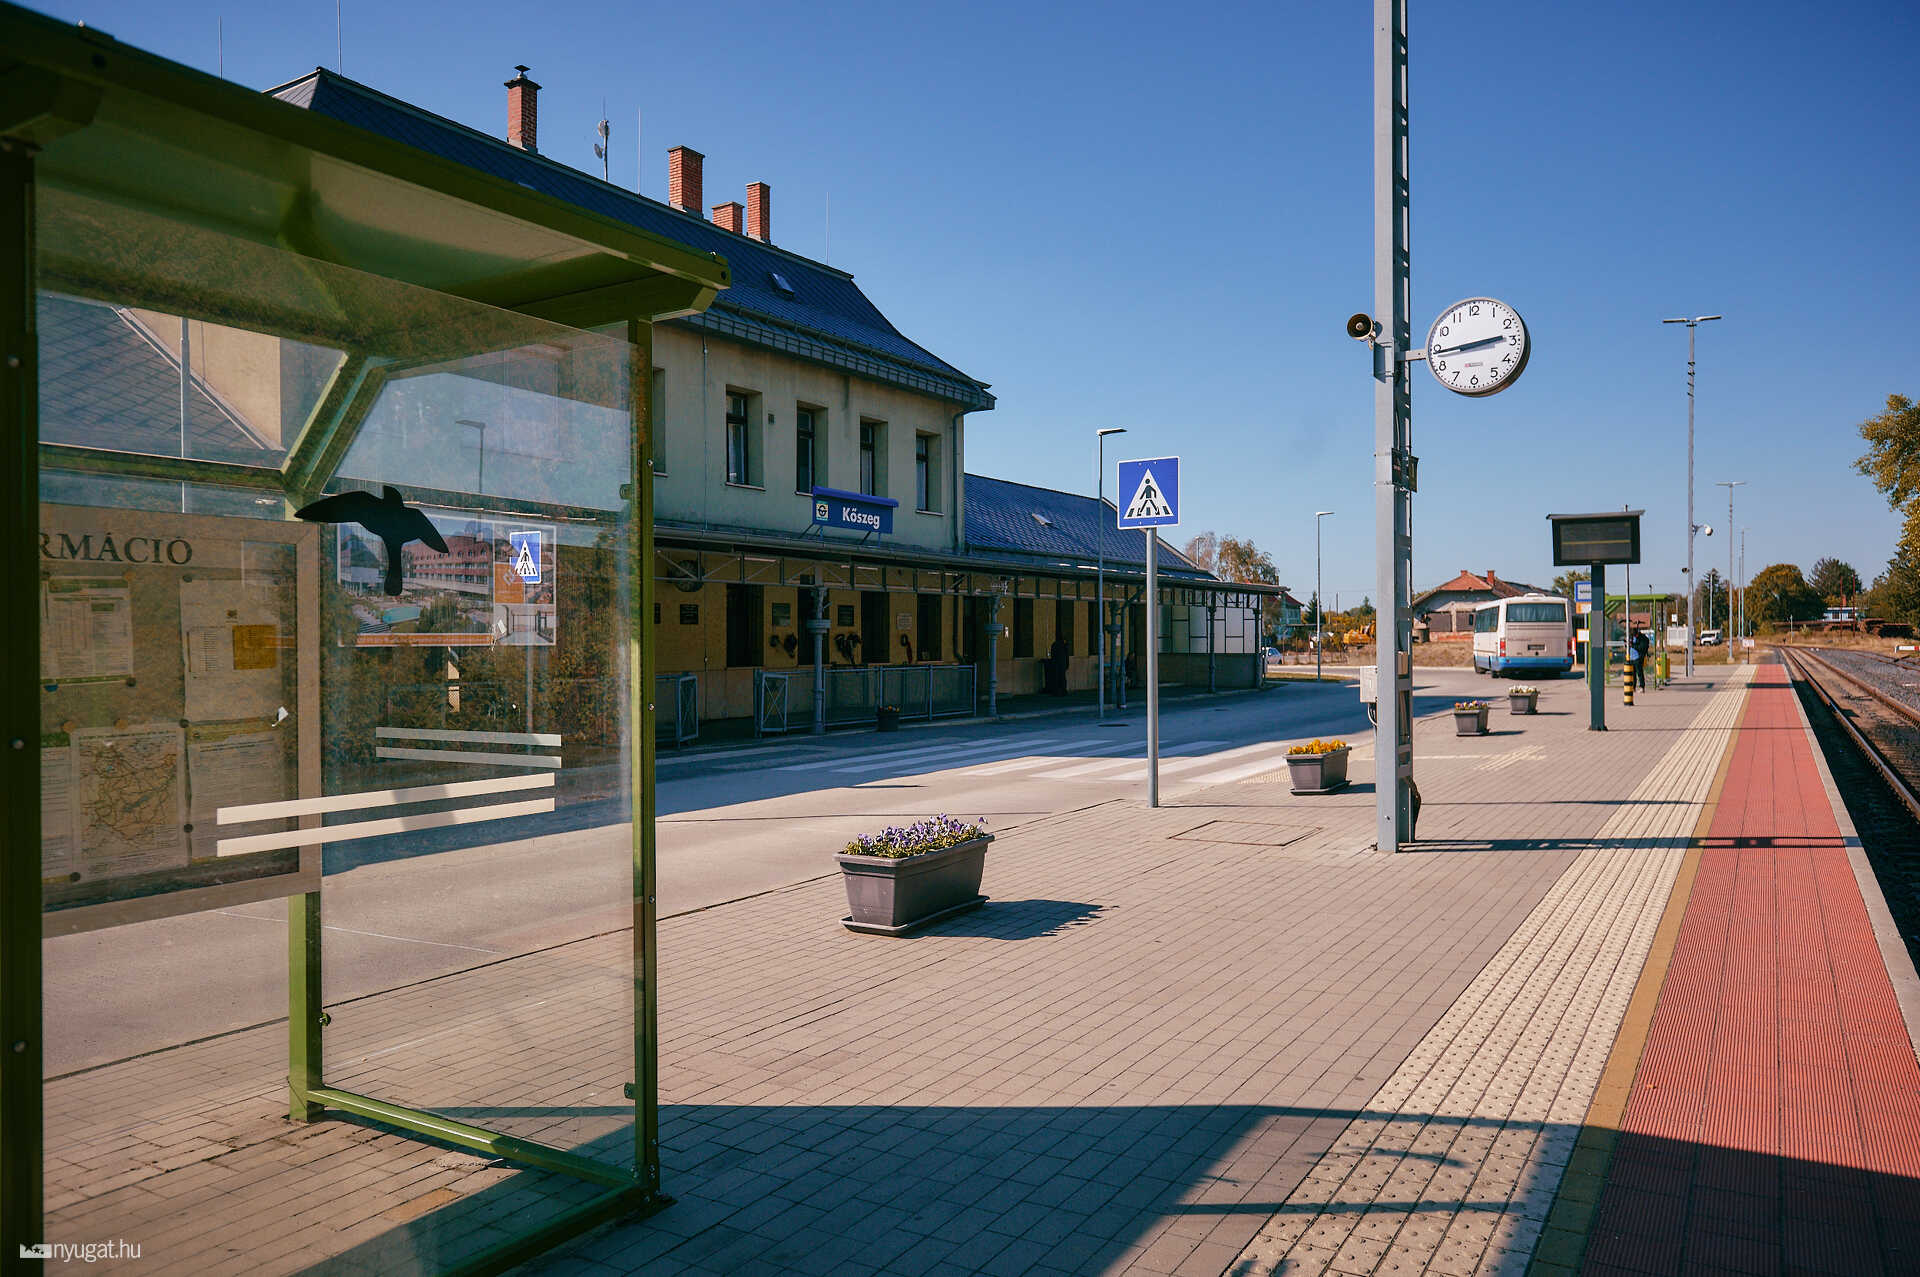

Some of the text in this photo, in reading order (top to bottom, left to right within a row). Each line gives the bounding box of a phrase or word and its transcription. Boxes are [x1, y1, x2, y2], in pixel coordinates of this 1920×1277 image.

[1469, 305, 1480, 316] 12
[1453, 312, 1462, 323] 11
[1503, 318, 1512, 329] 2
[1440, 326, 1449, 337] 10
[1508, 335, 1517, 346] 3
[1502, 353, 1511, 364] 4
[1438, 361, 1446, 371] 8
[1452, 371, 1460, 381] 7
[1490, 367, 1498, 378] 5
[1470, 374, 1478, 385] 6
[842, 506, 880, 529] Kőszeg
